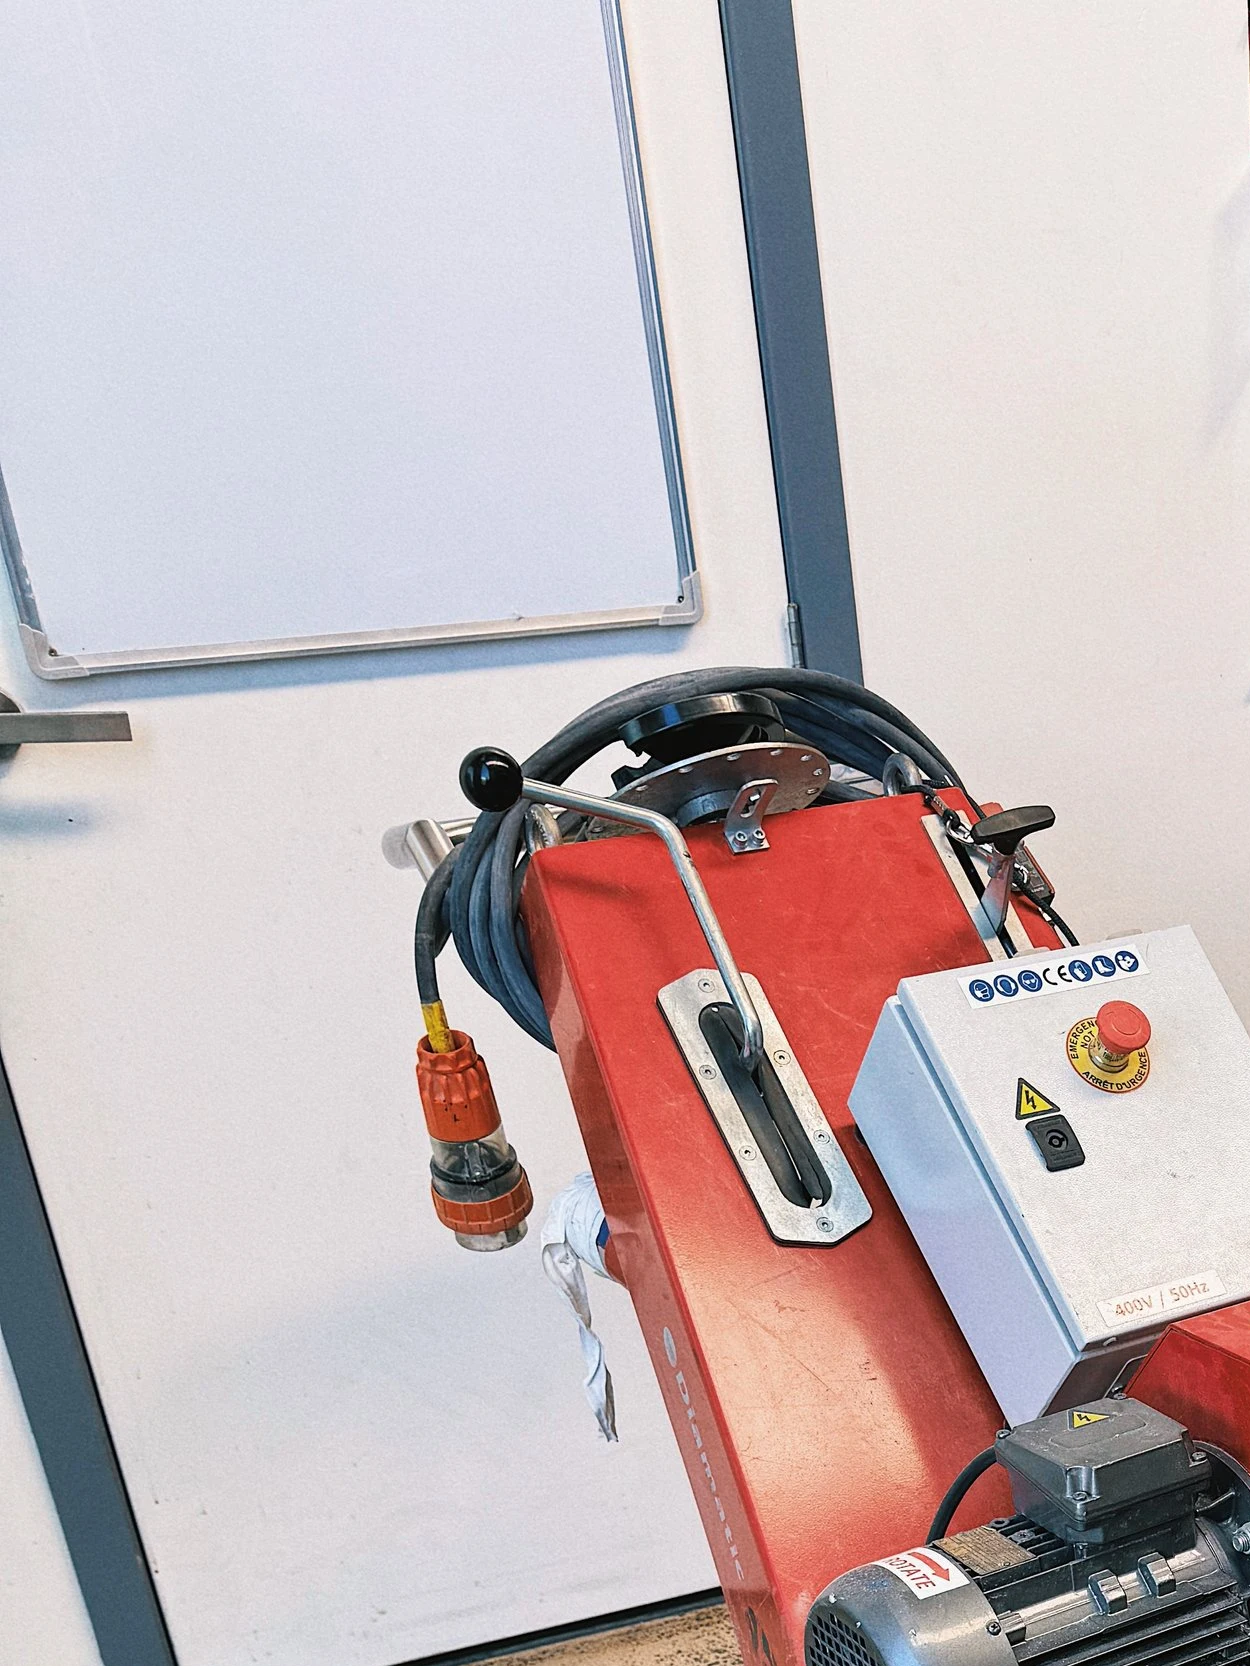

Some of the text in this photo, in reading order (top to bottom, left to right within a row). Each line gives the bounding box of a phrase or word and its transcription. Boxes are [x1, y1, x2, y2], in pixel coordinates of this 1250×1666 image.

[1069, 1020, 1096, 1060] EMERGEN
[1082, 1051, 1148, 1091] ARRÊT D'URGENCE
[1115, 1294, 1153, 1316] 400V
[1169, 1282, 1210, 1302] 50Hz
[883, 1556, 936, 1590] ROTATE
